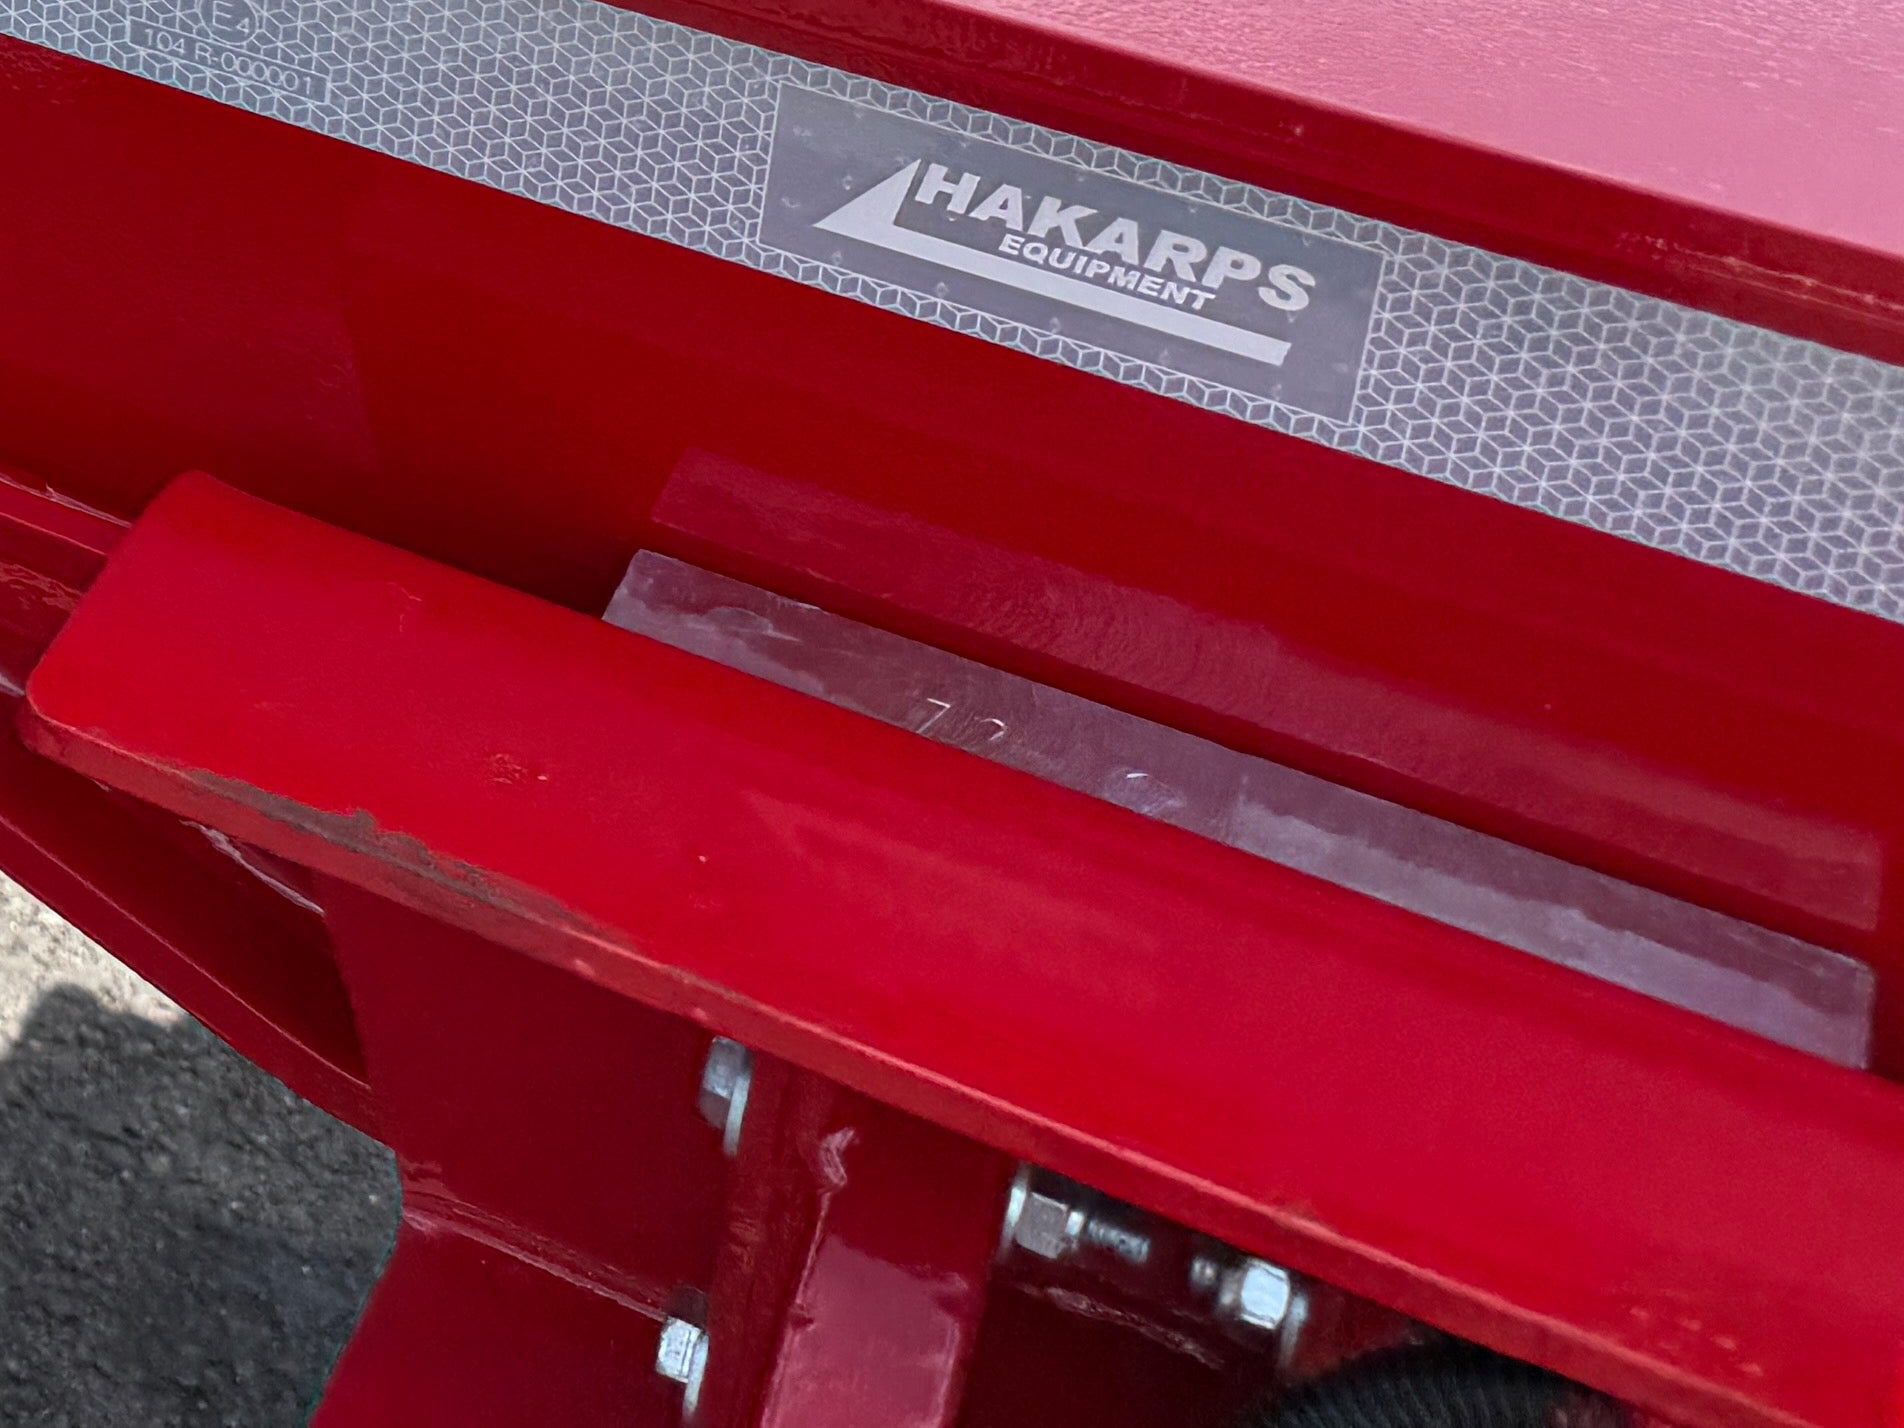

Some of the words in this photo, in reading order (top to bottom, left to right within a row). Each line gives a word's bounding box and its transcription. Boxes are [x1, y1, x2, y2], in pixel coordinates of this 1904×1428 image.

[145, 28, 185, 53] 104
[195, 43, 312, 95] R-000001
[914, 162, 1316, 312] HAKARPS
[998, 235, 1217, 312] EQUIPMENT
